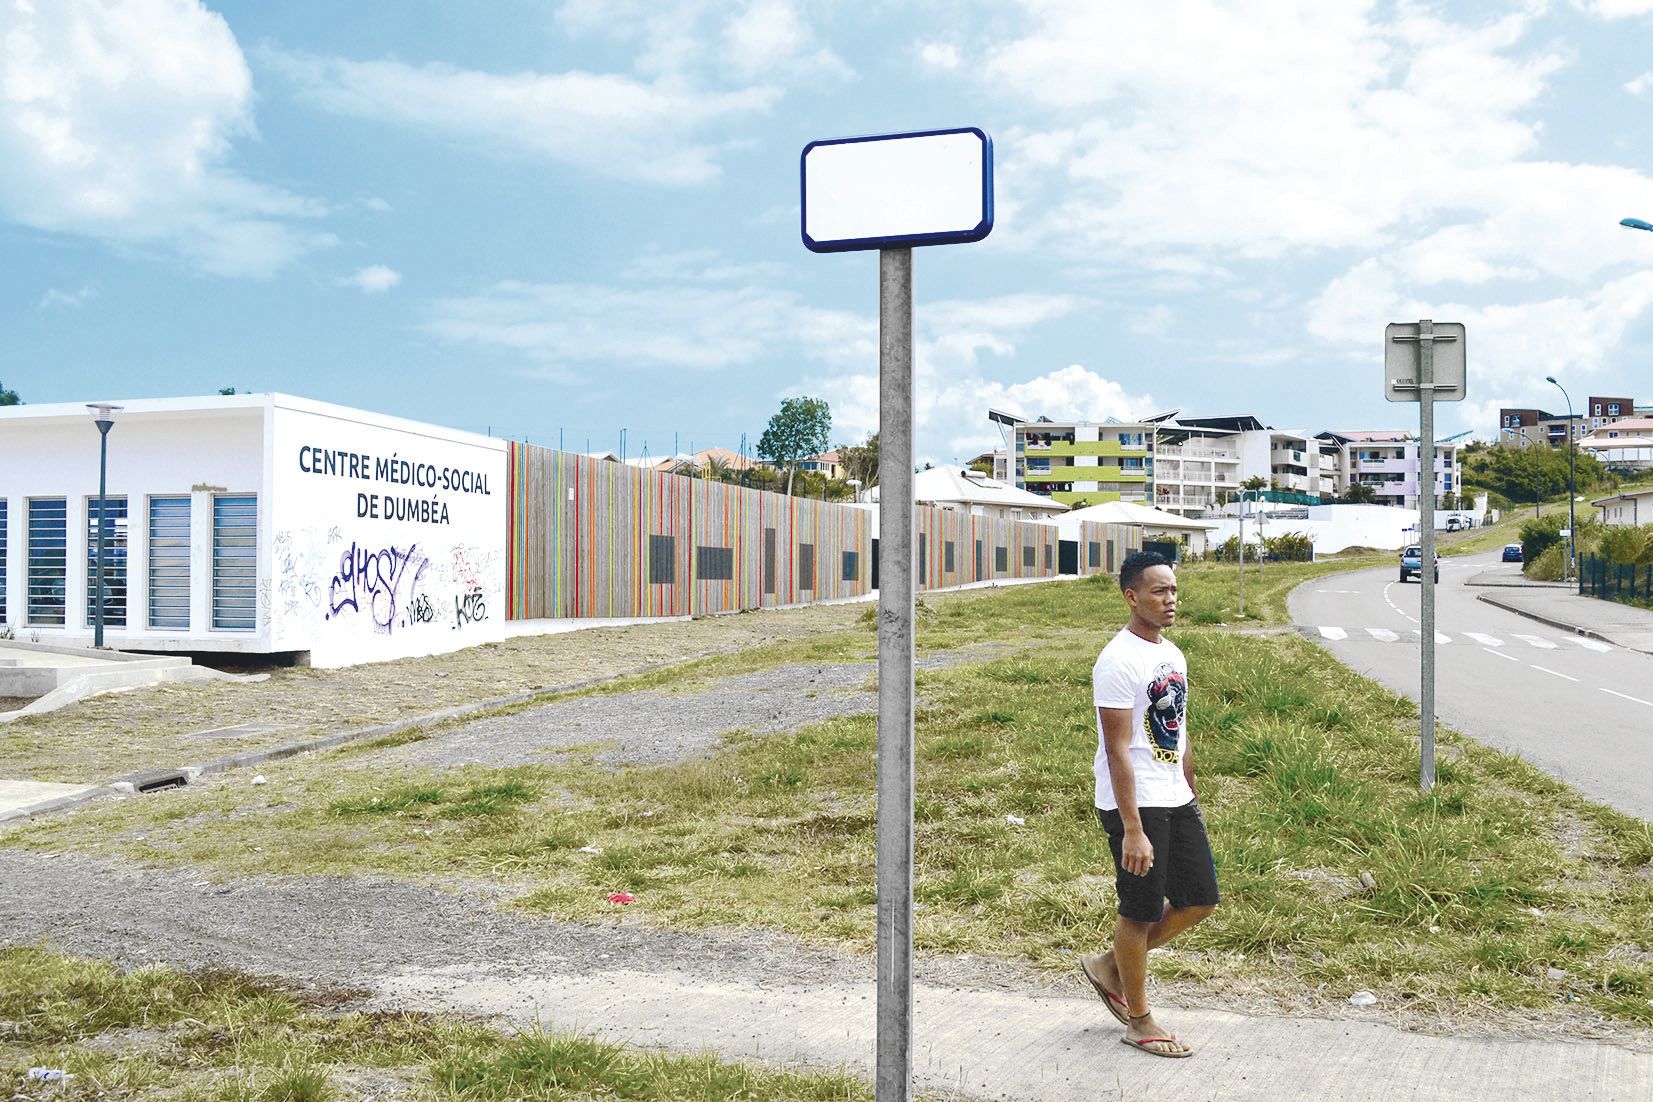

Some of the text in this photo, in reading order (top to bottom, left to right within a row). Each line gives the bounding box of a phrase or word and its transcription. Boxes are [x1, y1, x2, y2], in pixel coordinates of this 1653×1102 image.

[299, 445, 491, 496] CENTRE MÉDICO-SOCIAL
[357, 492, 450, 525] DE DUMBÉA
